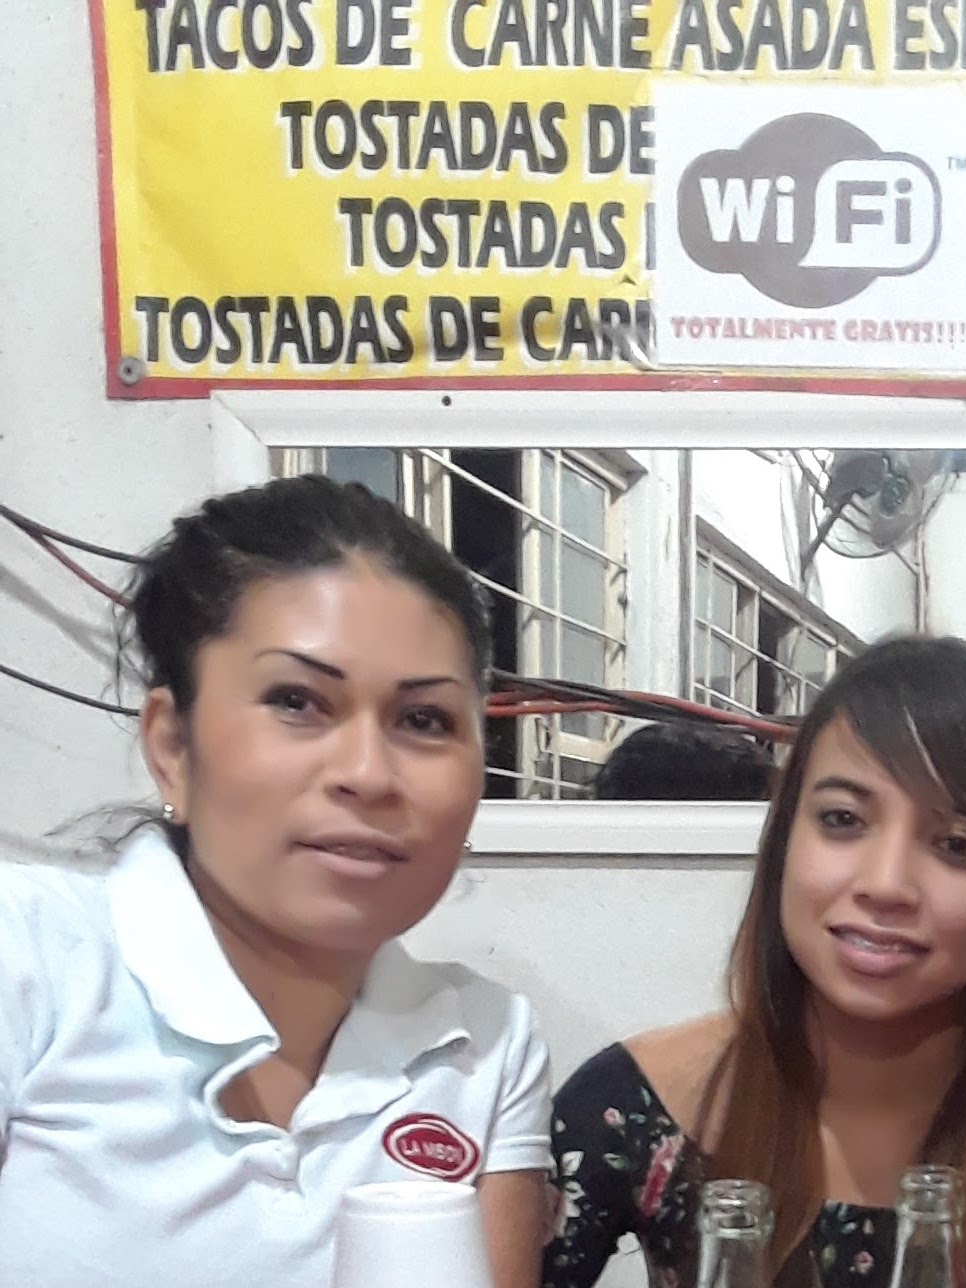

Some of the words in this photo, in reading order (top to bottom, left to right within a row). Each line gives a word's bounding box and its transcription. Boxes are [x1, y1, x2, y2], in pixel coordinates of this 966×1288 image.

[136, 0, 313, 72] TACOS
[336, 0, 414, 66] DE
[451, 0, 652, 68] CARNE
[671, 0, 874, 71] ASADA
[281, 101, 568, 173] TOSTADAS
[588, 104, 655, 175] DE
[340, 198, 626, 269] TOSTADAS
[135, 295, 413, 363] TOSTADAS
[429, 295, 503, 361] DE
[671, 316, 836, 340] TOTALMENTE
